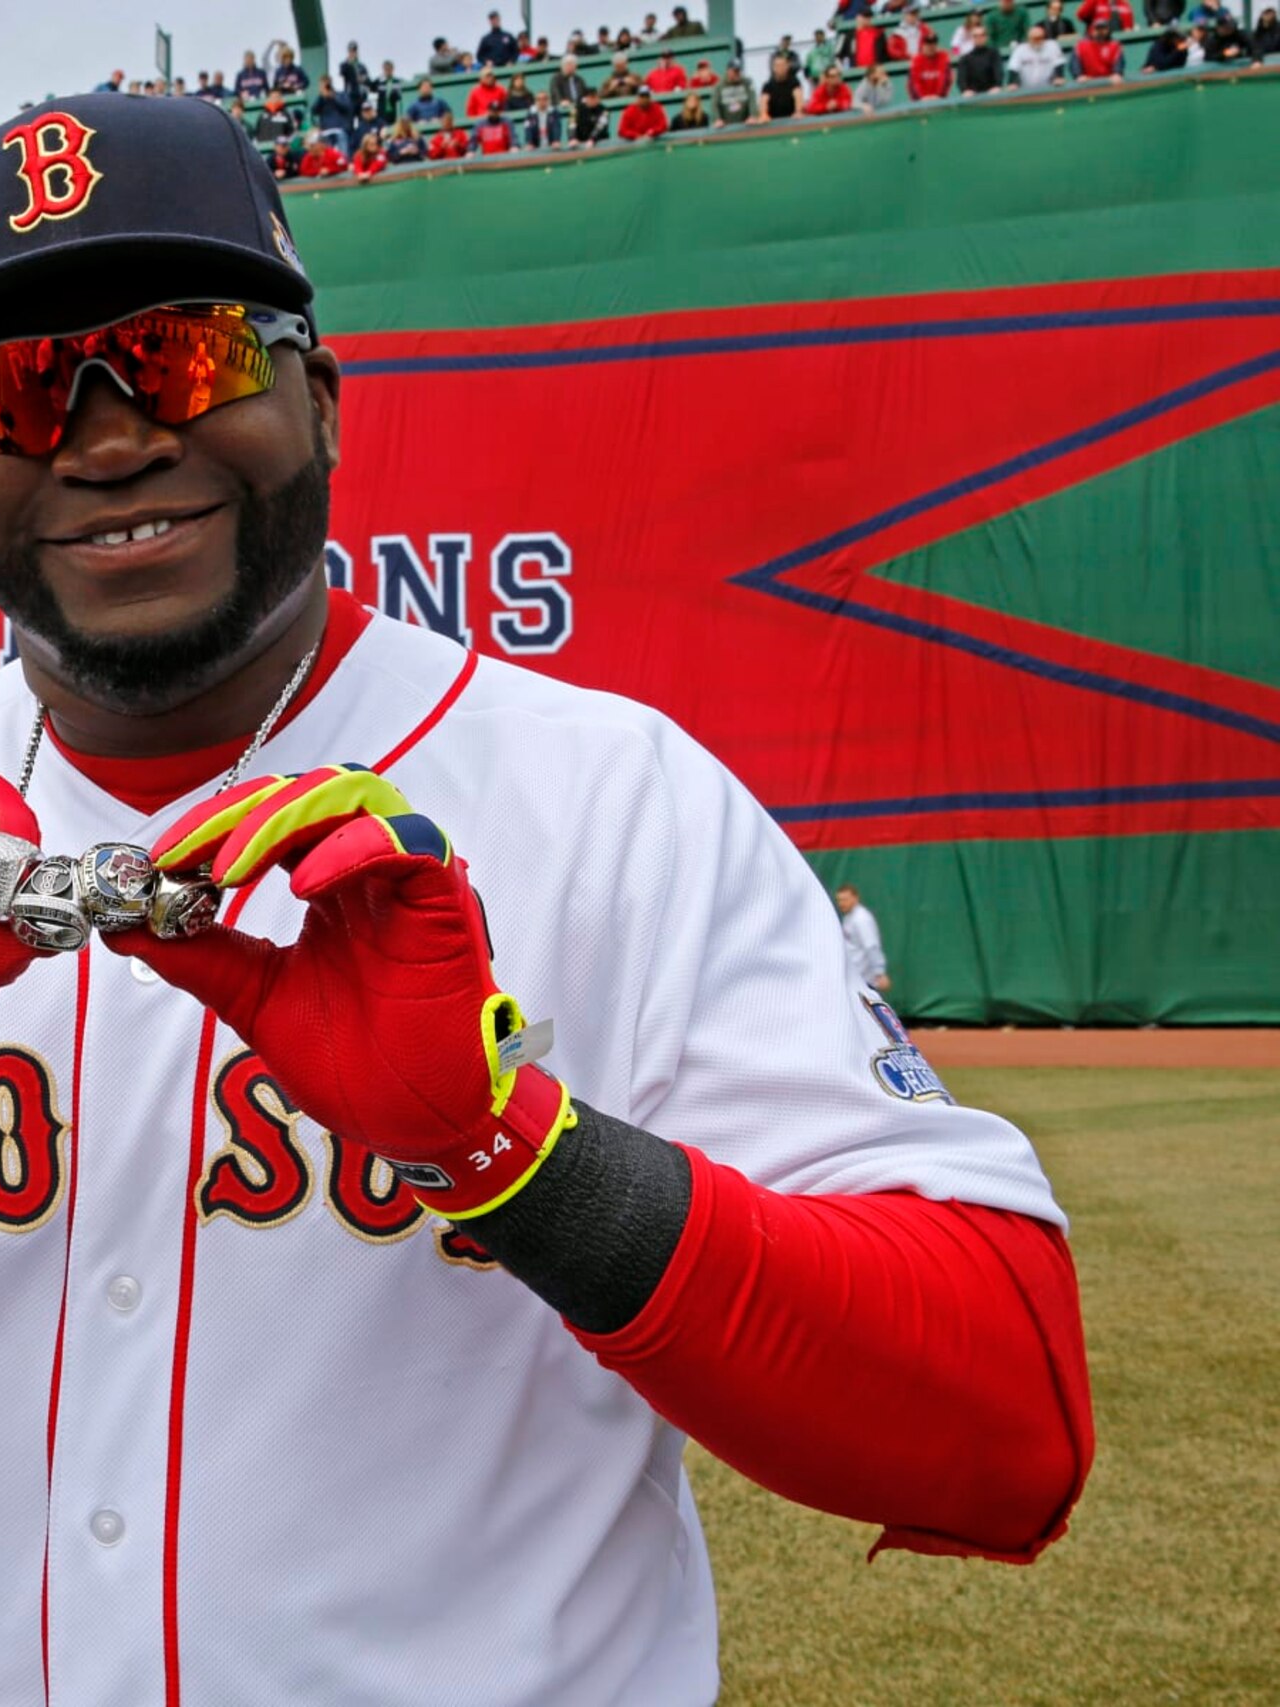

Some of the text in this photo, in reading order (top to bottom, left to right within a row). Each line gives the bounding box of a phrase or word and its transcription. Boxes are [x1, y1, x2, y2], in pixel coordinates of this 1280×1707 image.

[3, 111, 105, 232] B
[194, 1045, 505, 1271] SO
[468, 1131, 513, 1172] 34
